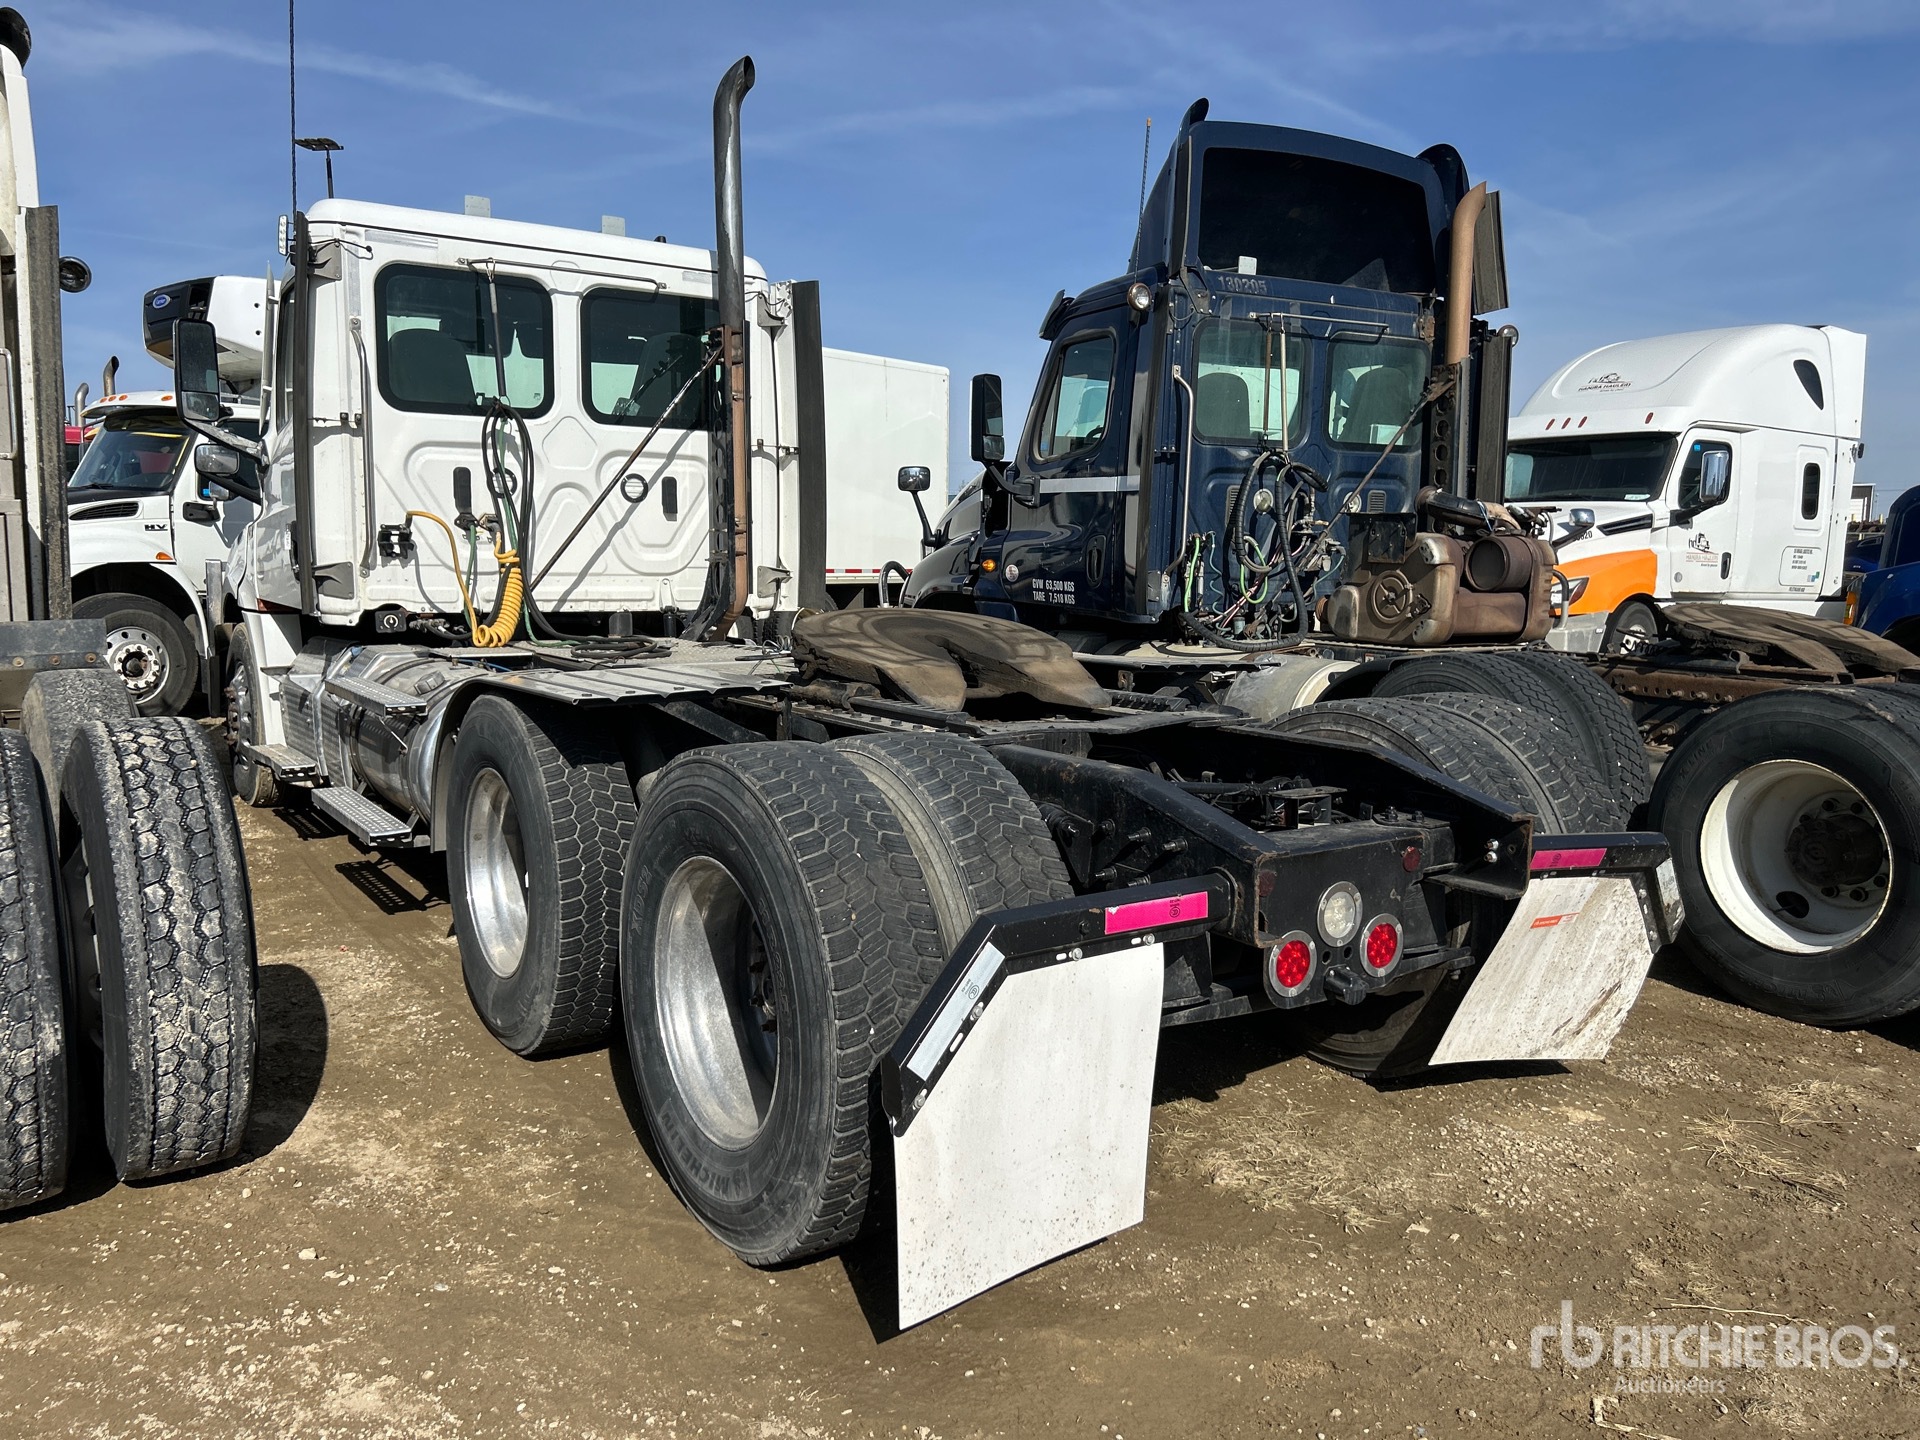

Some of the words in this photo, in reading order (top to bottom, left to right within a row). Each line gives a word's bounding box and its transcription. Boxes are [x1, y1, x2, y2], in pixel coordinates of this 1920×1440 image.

[144, 523, 167, 531] HV
[1032, 579, 1044, 589] GVW
[1064, 581, 1075, 592] KGS
[1032, 591, 1046, 602] TARE
[1064, 594, 1076, 605] KGS
[660, 1111, 733, 1196] MICHELIN
